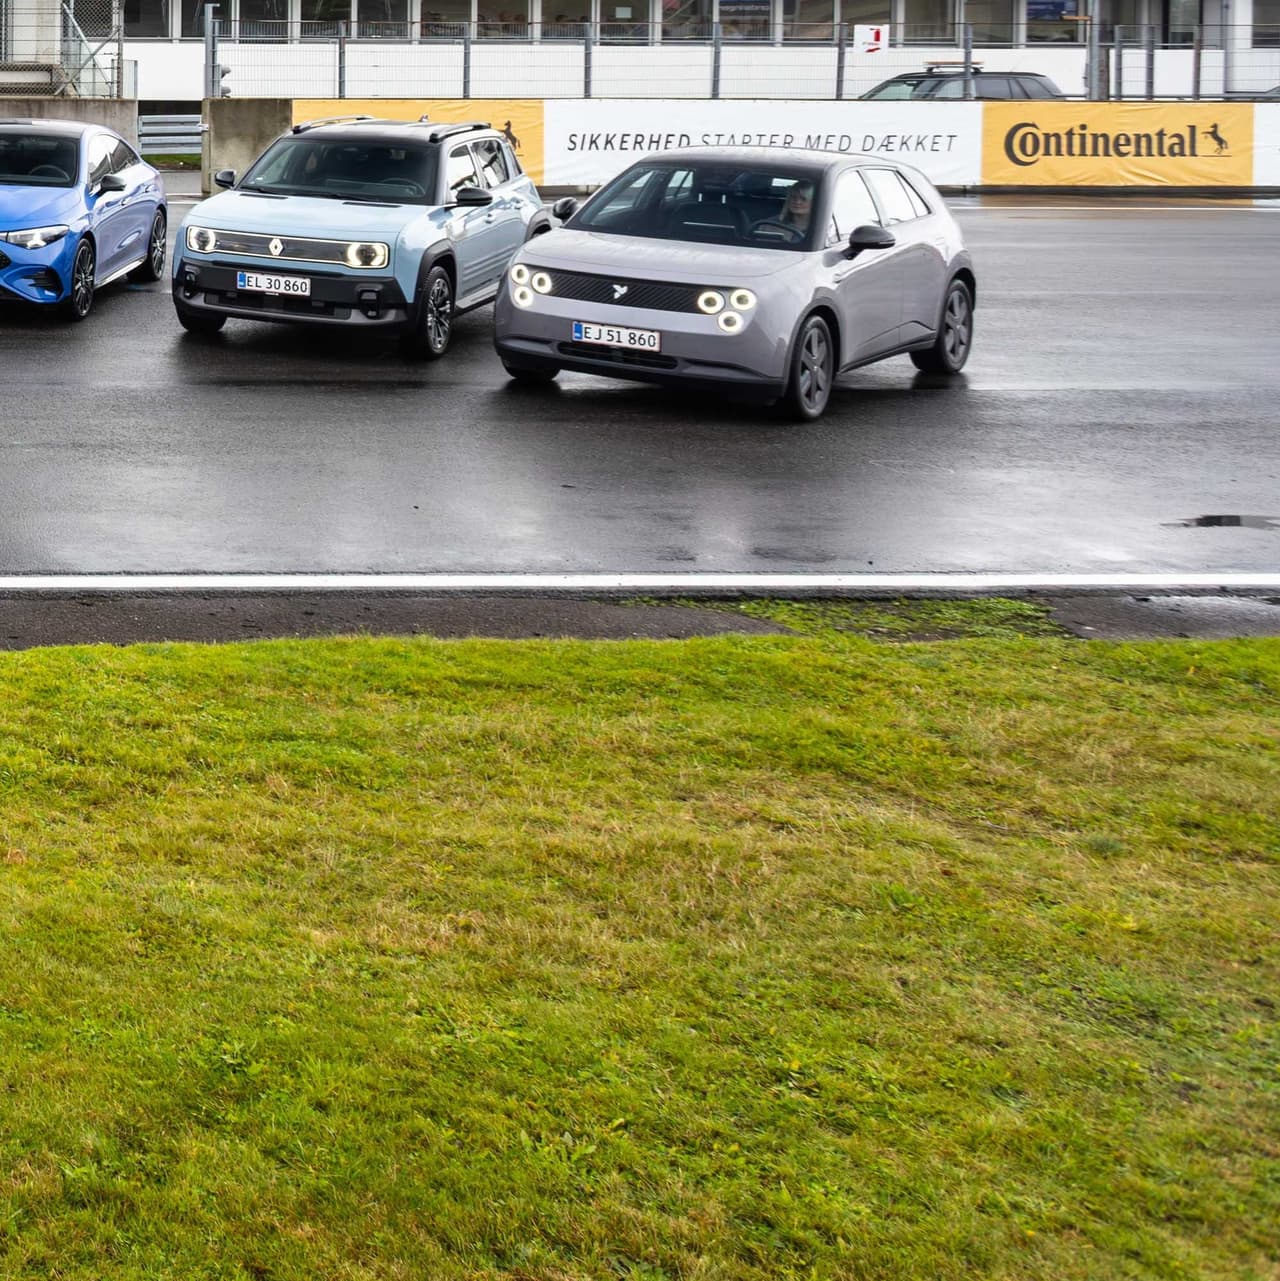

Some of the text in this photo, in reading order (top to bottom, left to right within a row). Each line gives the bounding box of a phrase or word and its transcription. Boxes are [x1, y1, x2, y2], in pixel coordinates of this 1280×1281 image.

[568, 133, 690, 151] SIKKERHED
[805, 134, 851, 151] MED
[861, 134, 957, 152] DÆKKET
[1004, 122, 1199, 166] Continental
[247, 276, 307, 293] EL 30 860
[584, 326, 656, 347] EJ 51 860
